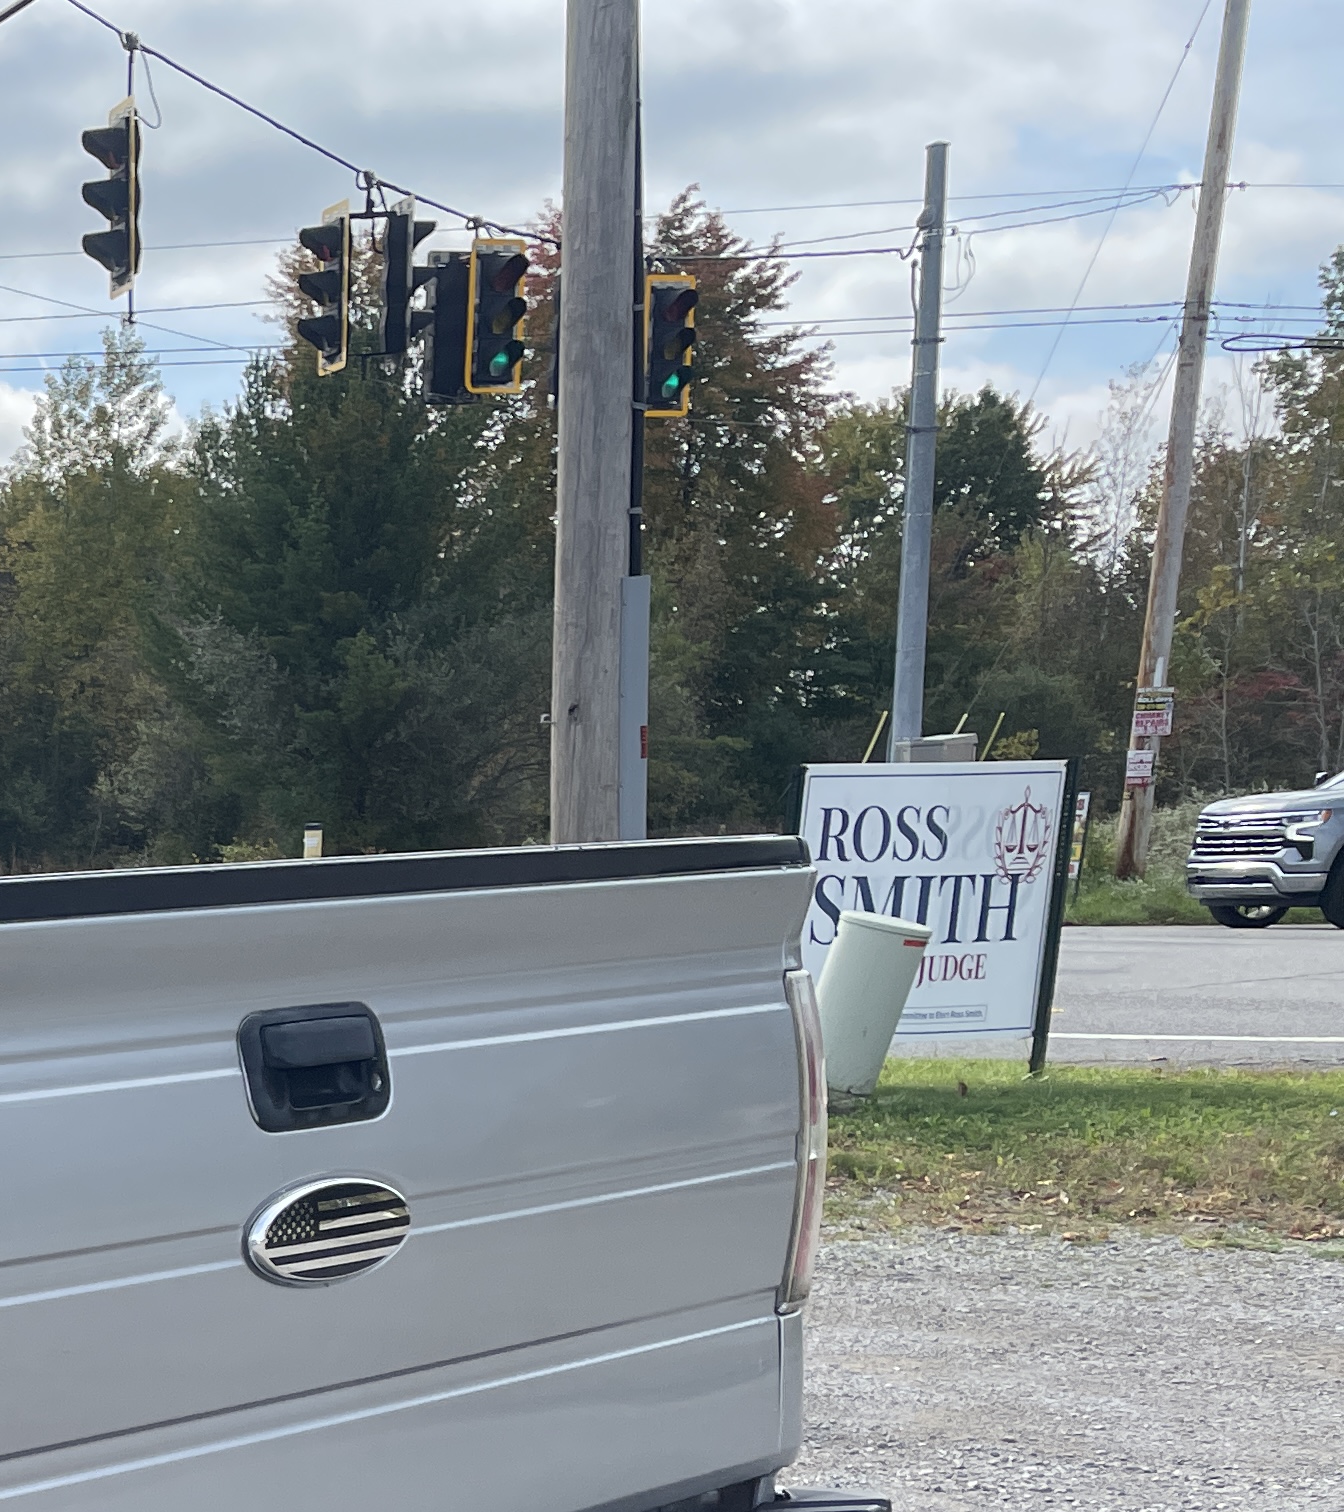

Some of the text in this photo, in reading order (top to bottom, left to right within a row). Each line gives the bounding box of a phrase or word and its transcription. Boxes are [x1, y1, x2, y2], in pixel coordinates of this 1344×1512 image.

[815, 804, 951, 863] ROSS
[809, 873, 1020, 945] SMITH
[915, 953, 988, 989] JUDGE
